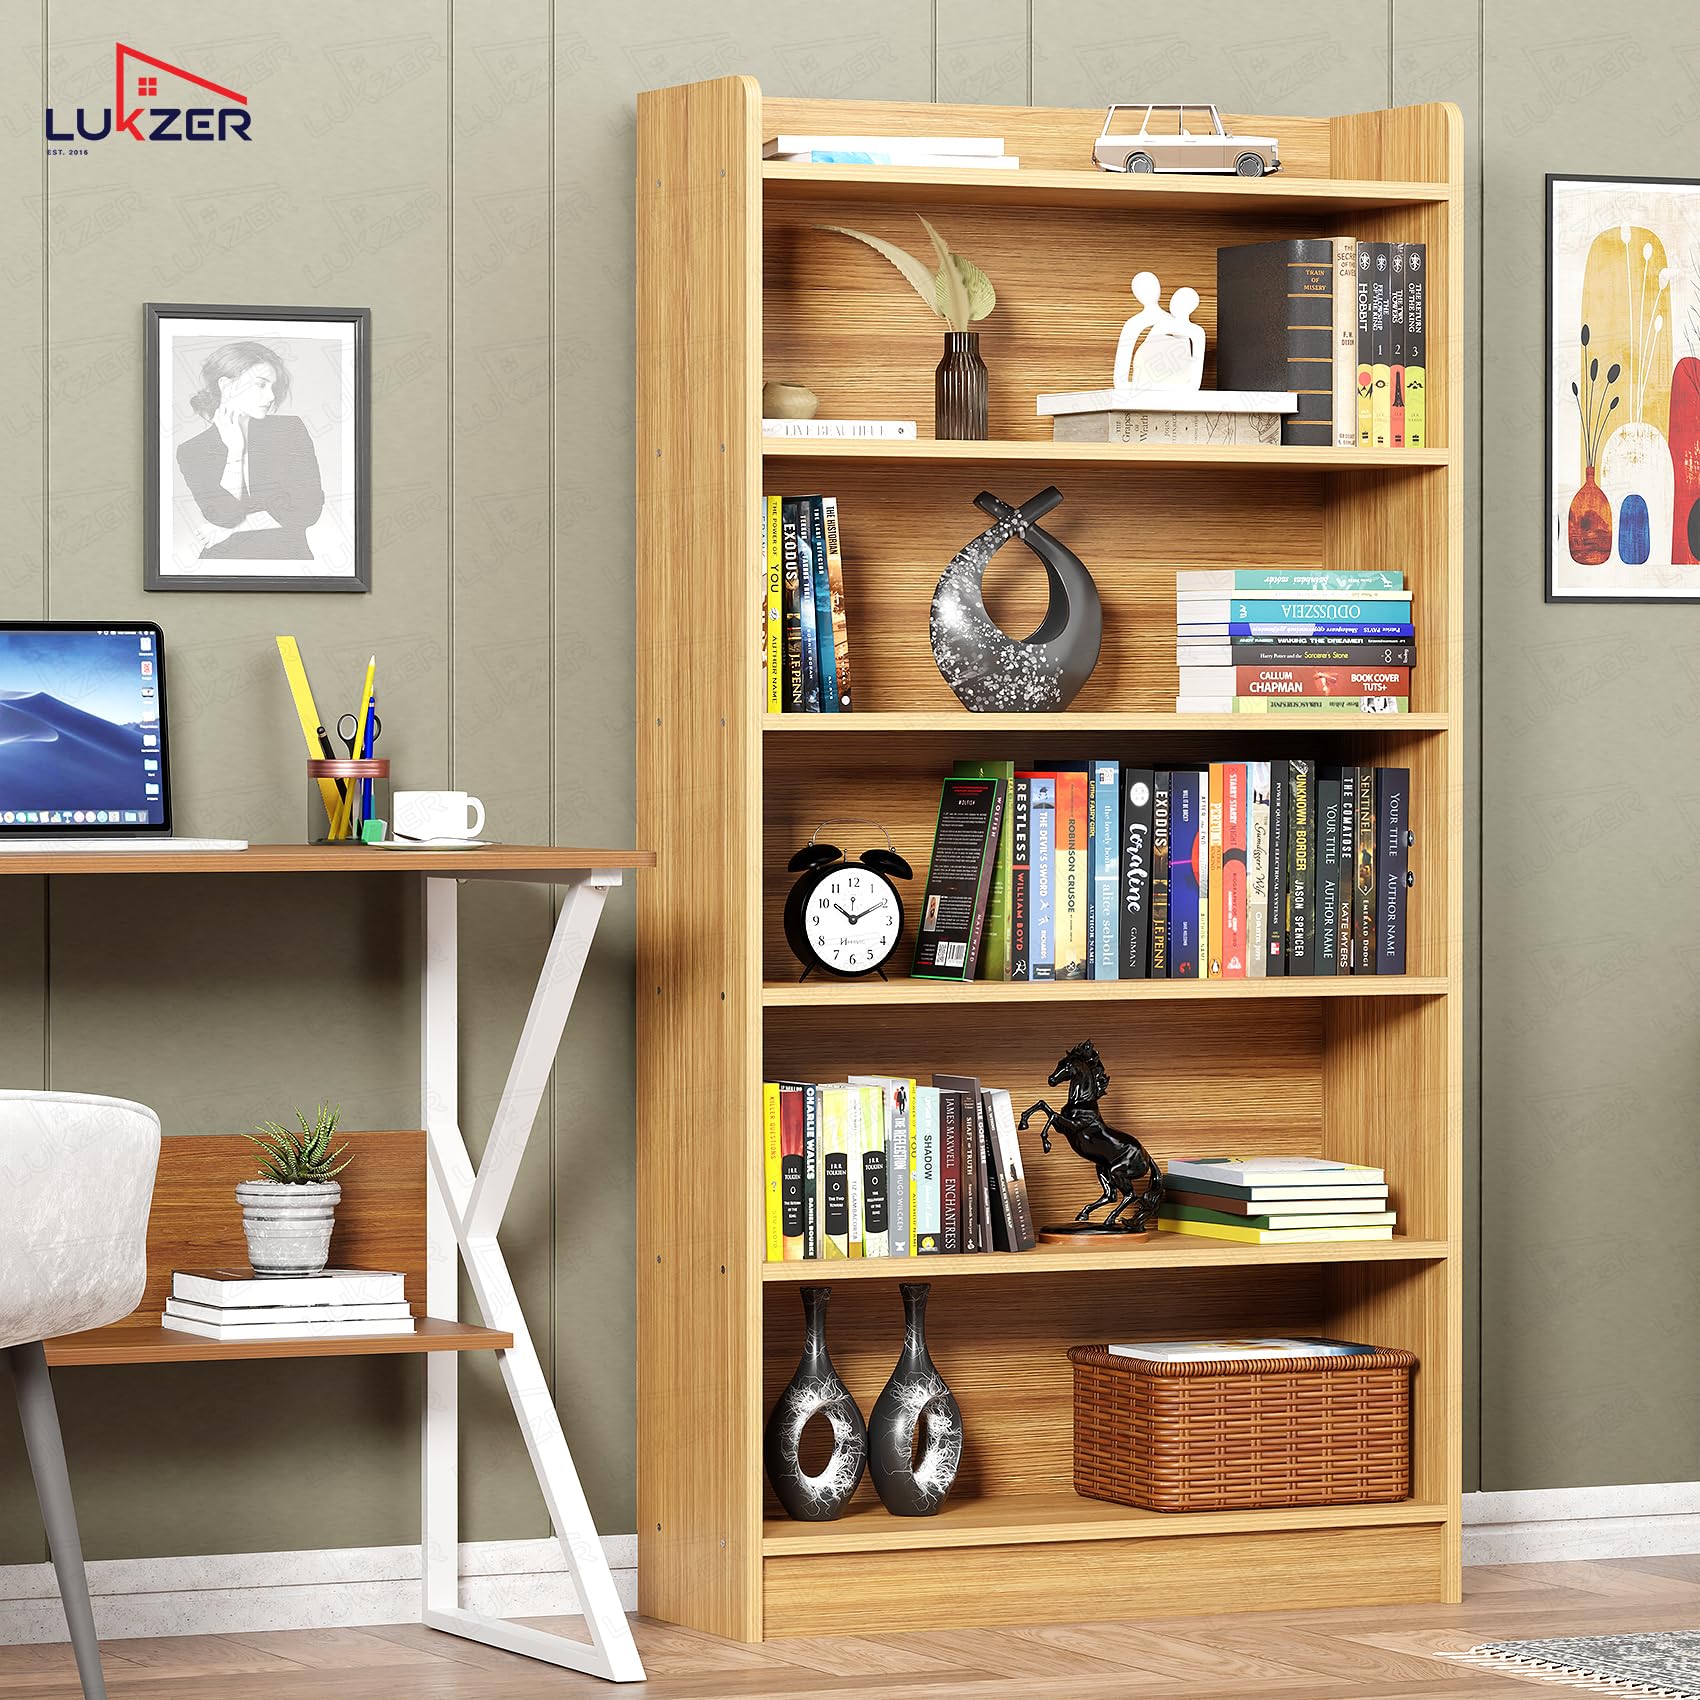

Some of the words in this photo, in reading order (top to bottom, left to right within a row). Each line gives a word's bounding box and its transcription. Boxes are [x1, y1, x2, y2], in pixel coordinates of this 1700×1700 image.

[1408, 282, 1415, 294] OF
[1358, 282, 1368, 332] HOBBIT
[1378, 344, 1383, 356] 1
[1394, 344, 1401, 355] 2
[1412, 346, 1419, 357] 3
[1121, 412, 1133, 443] Grapes
[1139, 415, 1149, 442] Wrath
[826, 506, 835, 519] THE
[772, 546, 778, 556] OF
[784, 523, 798, 580] EXODUS
[827, 519, 838, 555] HISTORIAN
[770, 564, 779, 593] YOU
[1249, 682, 1303, 693] CHAPMAN
[1259, 671, 1293, 681] CALLUM
[1351, 673, 1374, 683] BOOK
[1374, 673, 1400, 683] COVER
[1362, 683, 1388, 692] TUTS+
[1229, 773, 1237, 799] STARRY
[1296, 774, 1307, 825] UNKNOWN
[1343, 778, 1353, 797] THE
[991, 797, 1002, 838] WOLFISH
[1104, 805, 1113, 820] the
[1155, 790, 1168, 847] EXODUS
[1229, 799, 1237, 824] STARRY
[1326, 804, 1338, 834] YOUR
[1360, 775, 1372, 836] SENTINEL
[1389, 793, 1401, 825] YOUR
[1016, 783, 1027, 862] RESTLESS
[1039, 812, 1048, 829] THE
[1102, 820, 1113, 846] lovely
[1342, 802, 1353, 859] COMATOSE
[1039, 830, 1048, 862] DEVIL'S
[1068, 819, 1076, 872] ROBINSON
[1296, 830, 1306, 871] BORDER
[1325, 836, 1336, 865] TITLE
[1389, 827, 1398, 857] TITLE
[848, 877, 860, 888] 12
[1039, 863, 1048, 897] SWORD
[1126, 823, 1148, 913] Coraline
[831, 884, 840, 894] 11
[870, 884, 874, 894] 1
[1016, 872, 1025, 919] WILLIAM
[1067, 874, 1075, 913] CRUSOE
[1253, 873, 1266, 898] Wife
[1294, 879, 1304, 909] JASON
[1387, 873, 1398, 921] AUTHOR
[819, 898, 830, 909] 10
[881, 897, 888, 909] 2
[1102, 884, 1114, 918] alice
[1324, 880, 1336, 926] AUTHOR
[1341, 902, 1349, 929] KATE
[812, 915, 820, 927] 9
[886, 915, 893, 927] 3
[974, 913, 982, 935] MATT
[1362, 899, 1370, 937] EMERALD
[818, 935, 825, 947] 8
[880, 935, 886, 946] 4
[969, 939, 978, 963] WARD
[1015, 922, 1024, 951] BOYD
[1102, 919, 1114, 966] sebold
[1129, 927, 1138, 967] GAIMAN
[1294, 916, 1304, 957] SPENCER
[1324, 928, 1333, 958] NAME
[1340, 931, 1348, 968] MYERS
[1387, 924, 1396, 957] NAME
[833, 949, 840, 960] 7
[849, 954, 856, 965] 6
[867, 949, 874, 960] 5
[806, 1087, 815, 1138] CHARLIE
[895, 1116, 906, 1129] THE
[945, 1098, 955, 1124] JAMES
[806, 1140, 815, 1180] WALKS
[893, 1129, 907, 1170] REFLECTION
[924, 1134, 933, 1180] SHADOW
[945, 1126, 955, 1168] MAXWELL
[896, 1174, 904, 1196] HUGO
[896, 1197, 904, 1231] WILCKEN
[945, 1178, 956, 1249] ENCHANTRESS
